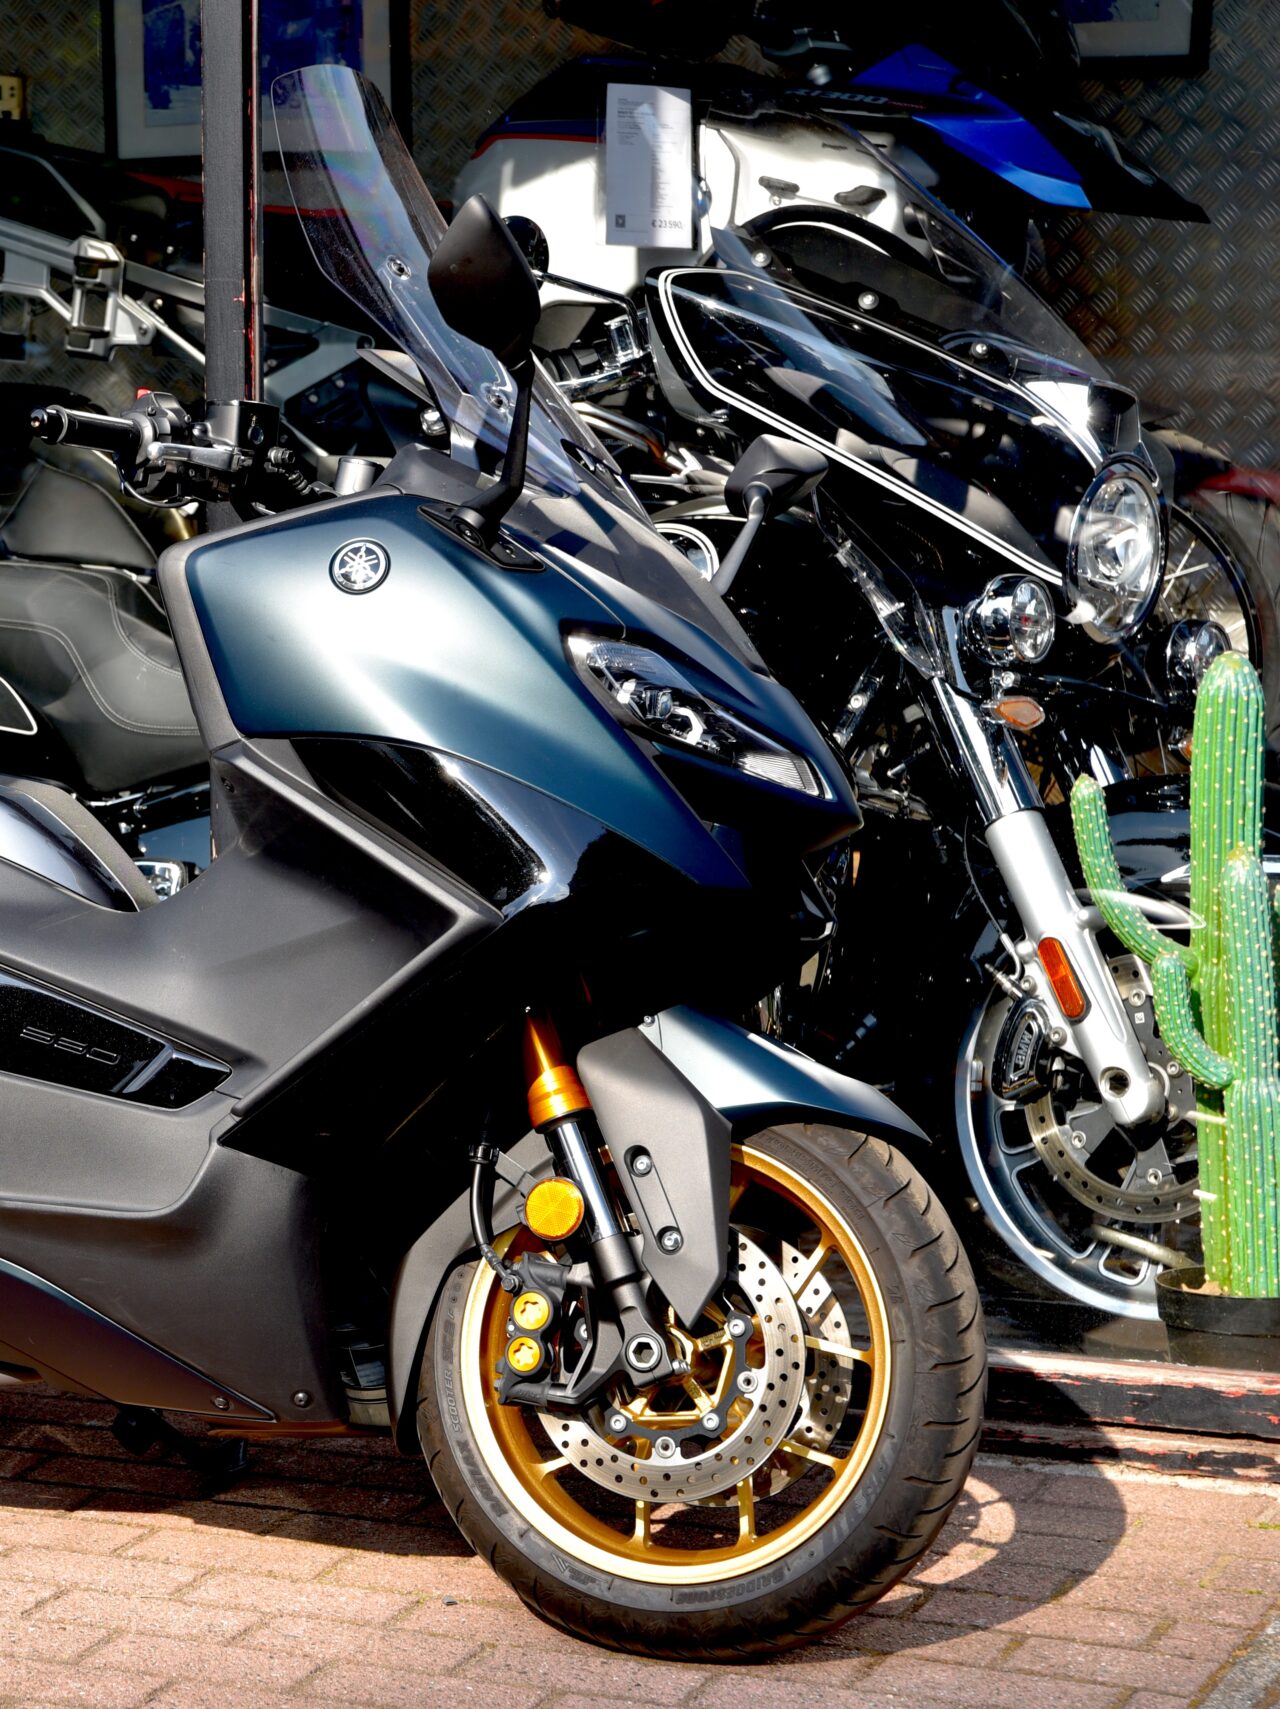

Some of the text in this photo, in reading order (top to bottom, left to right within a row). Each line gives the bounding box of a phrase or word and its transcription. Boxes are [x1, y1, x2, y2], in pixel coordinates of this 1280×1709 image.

[1014, 1030, 1033, 1068] BMW
[443, 1369, 462, 1432] SCOOTER
[675, 1564, 787, 1605] BRIDGESTONE
